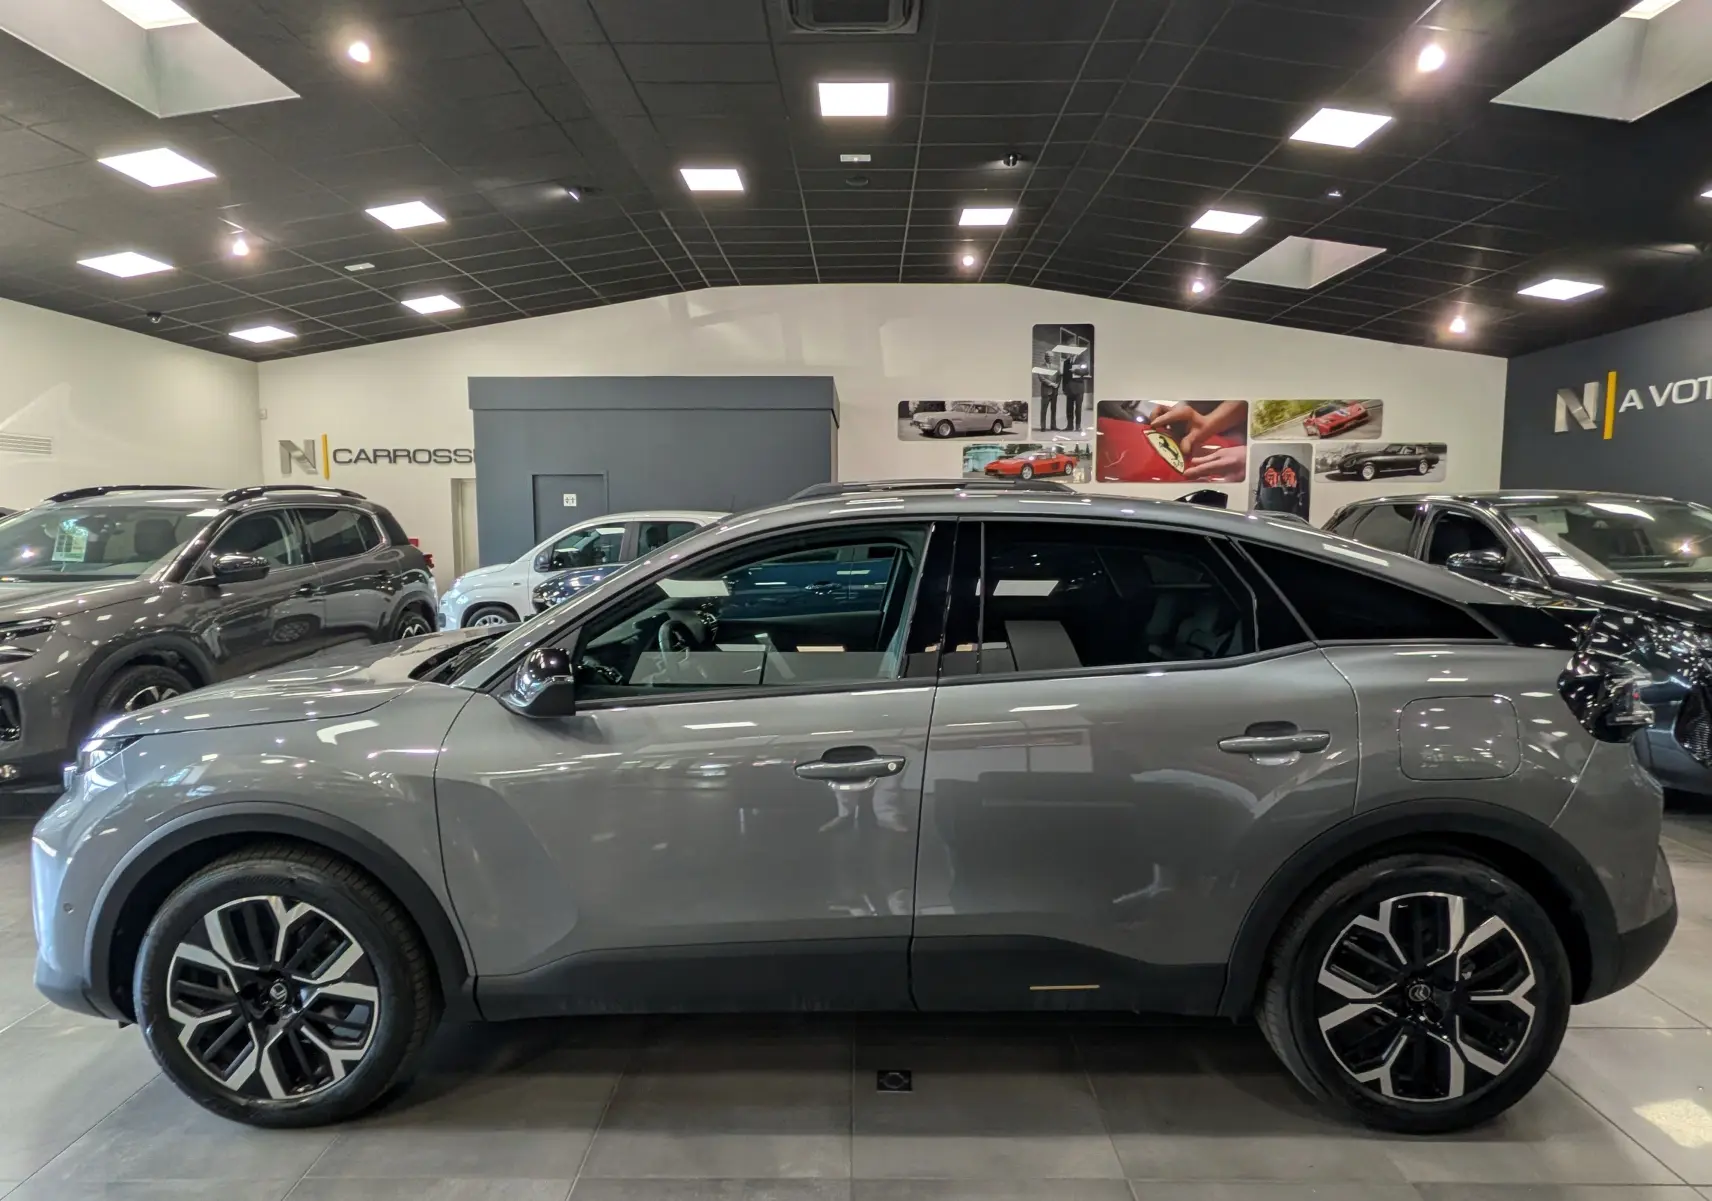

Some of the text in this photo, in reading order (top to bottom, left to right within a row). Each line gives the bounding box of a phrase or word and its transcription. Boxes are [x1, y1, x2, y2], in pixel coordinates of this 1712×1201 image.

[1554, 381, 1599, 433] N
[1618, 388, 1645, 413] A
[278, 439, 475, 475] N CARROSS
